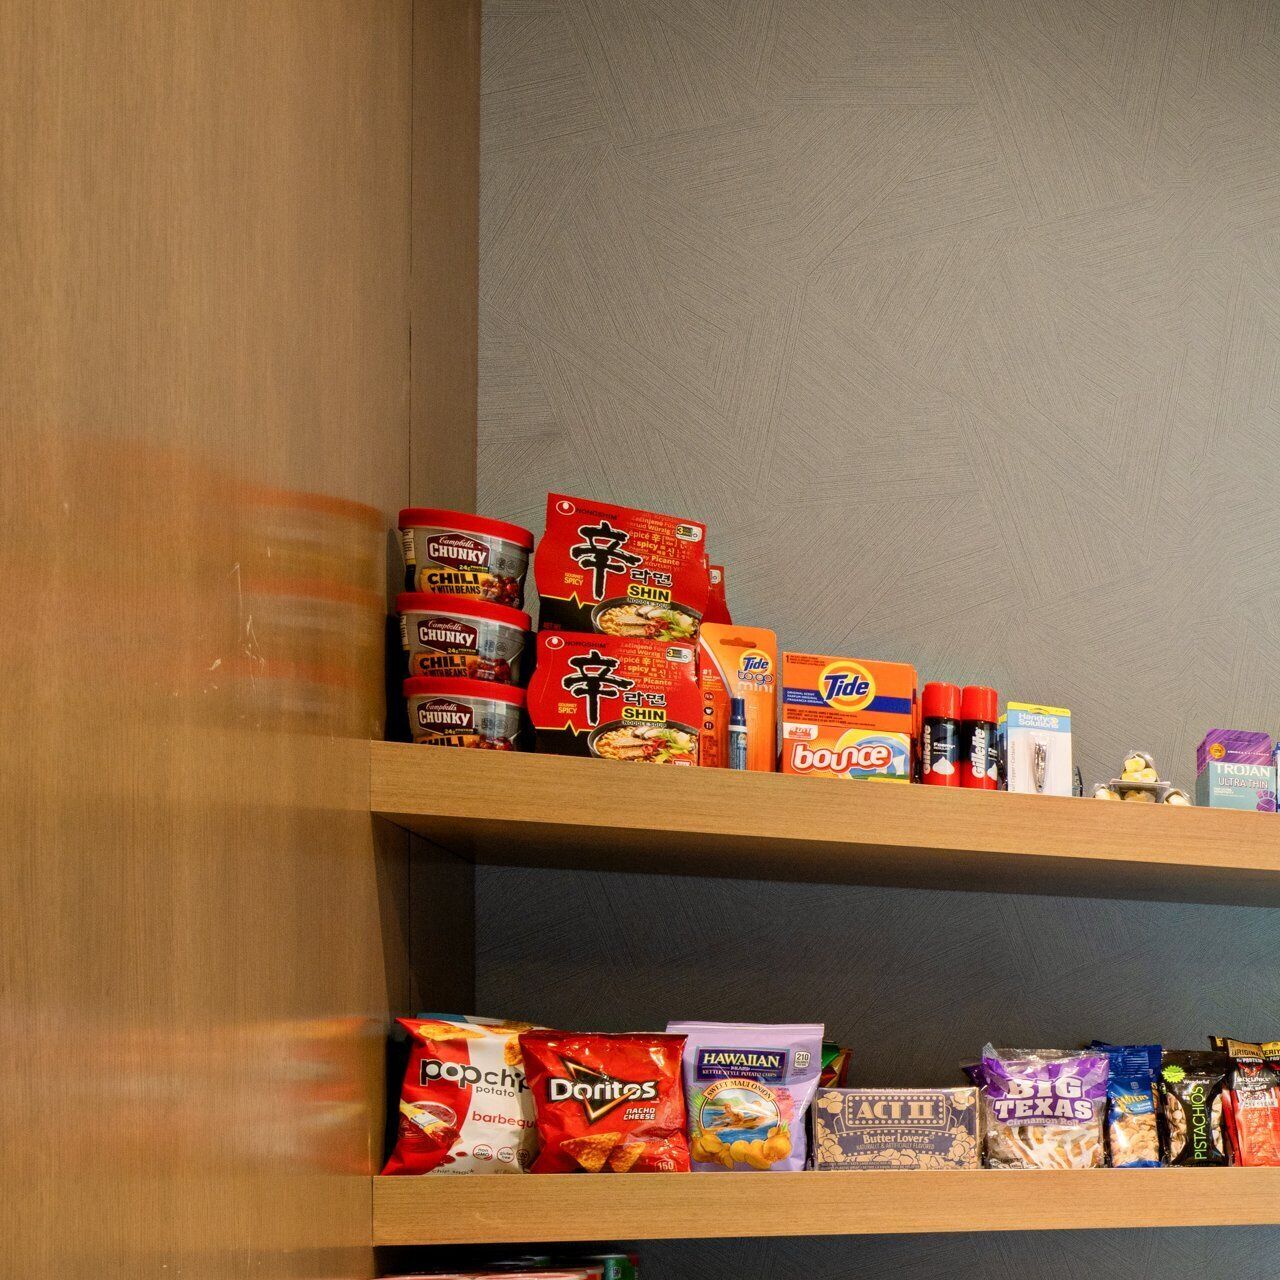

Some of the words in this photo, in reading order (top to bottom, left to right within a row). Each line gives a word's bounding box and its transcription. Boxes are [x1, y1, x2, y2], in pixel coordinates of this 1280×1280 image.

[429, 542, 487, 565] CHUNKY
[569, 519, 643, 601] 辛
[427, 573, 480, 585] CHILI
[563, 577, 584, 586] SPICY
[629, 569, 673, 587] 라면
[437, 585, 454, 594] WITH
[456, 585, 480, 594] BEANS
[627, 584, 672, 603] SHIN
[420, 627, 474, 646] CHUNKY
[419, 656, 467, 670] CHILI
[743, 656, 768, 671] Tide
[561, 649, 635, 727] 辛
[824, 673, 870, 701] Tide
[622, 692, 667, 707] 라면
[419, 710, 470, 726] CHUNKY
[557, 706, 578, 714] SPICY
[621, 707, 667, 721] SHIN
[792, 744, 892, 772] bounce
[971, 726, 986, 779] Gillette
[1216, 761, 1270, 777] TROJAN
[1218, 776, 1247, 787] ULTRA
[1248, 778, 1268, 790] THIN
[703, 1052, 780, 1068] HAWAIIAN
[796, 1053, 809, 1061] 210
[476, 1086, 515, 1097] potato
[550, 1079, 657, 1101] Doritos
[1006, 1077, 1083, 1098] BIG
[856, 1101, 904, 1119] ACT
[908, 1101, 935, 1119] II
[995, 1099, 1093, 1119] TEXAS
[1191, 1086, 1207, 1160] PISTACHIOS
[863, 1134, 896, 1143] Butter
[897, 1134, 930, 1143] Lovers
